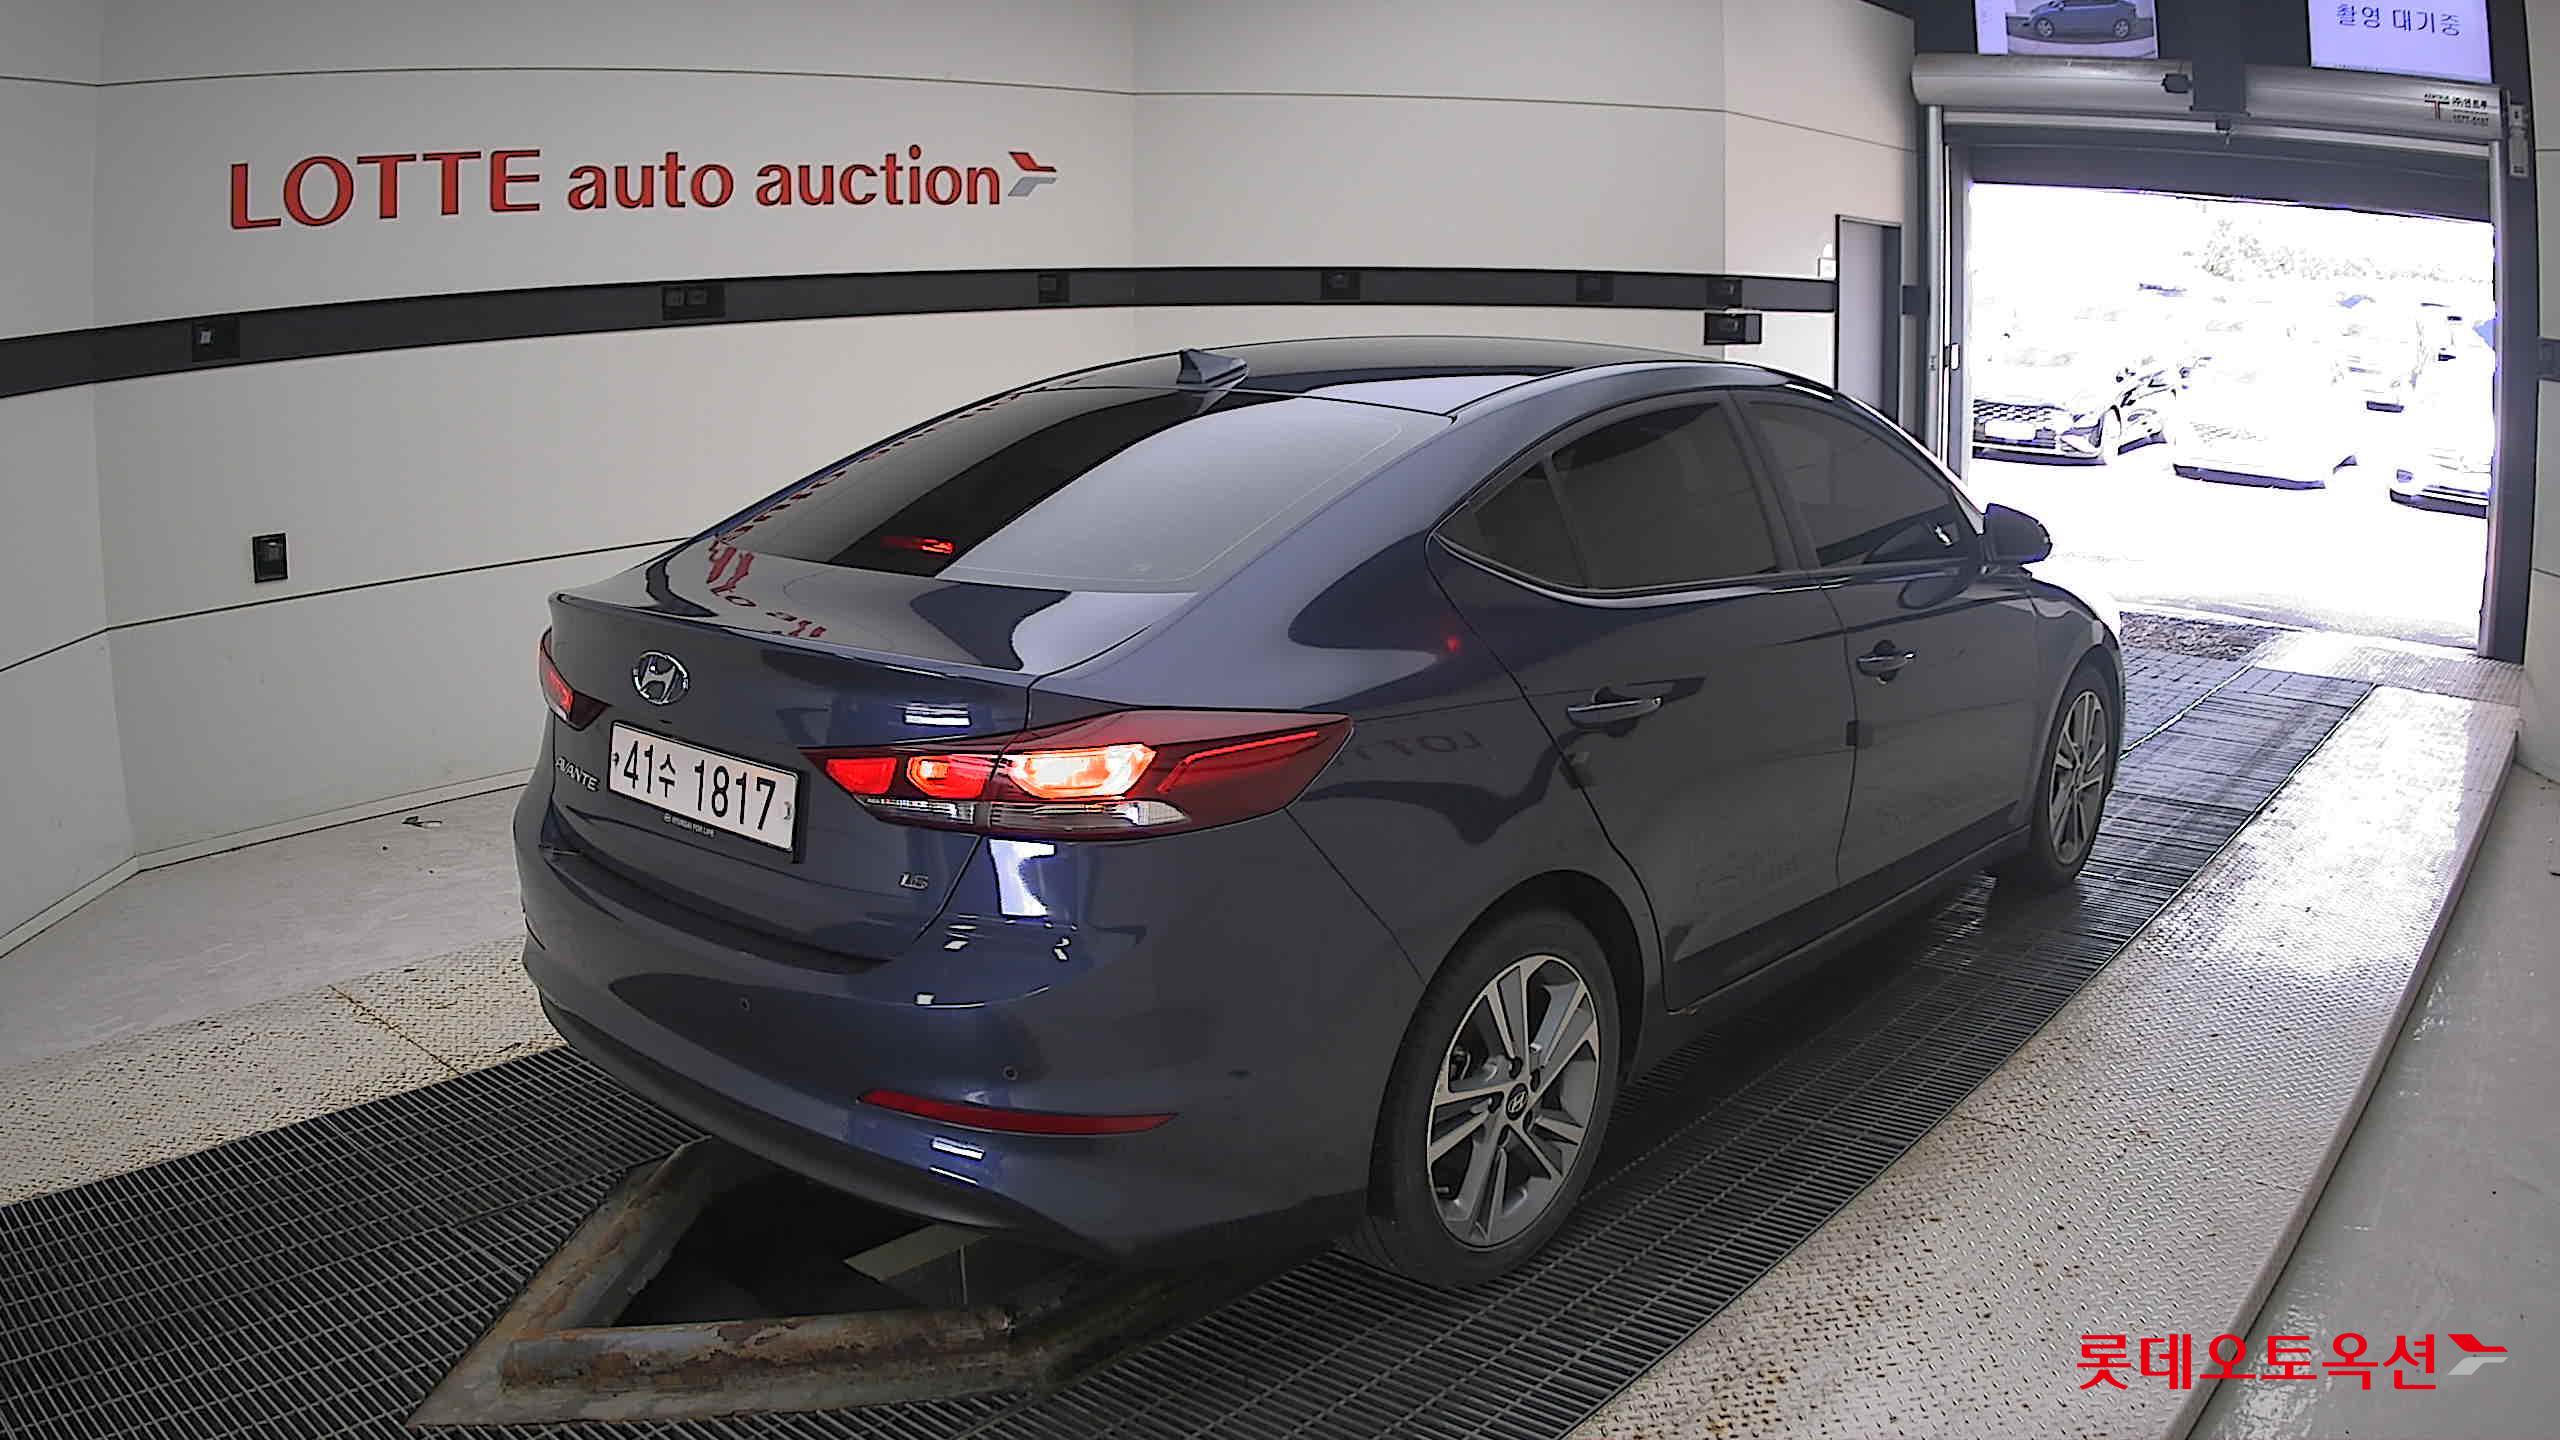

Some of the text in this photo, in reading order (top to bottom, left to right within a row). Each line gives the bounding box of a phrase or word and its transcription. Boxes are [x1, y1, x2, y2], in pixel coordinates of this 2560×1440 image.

[2336, 3, 2461, 37] 촬영 대기중
[231, 145, 1001, 231] LOTTE auto auction
[555, 756, 598, 791] AVANTE
[623, 740, 777, 831] 41수 1817
